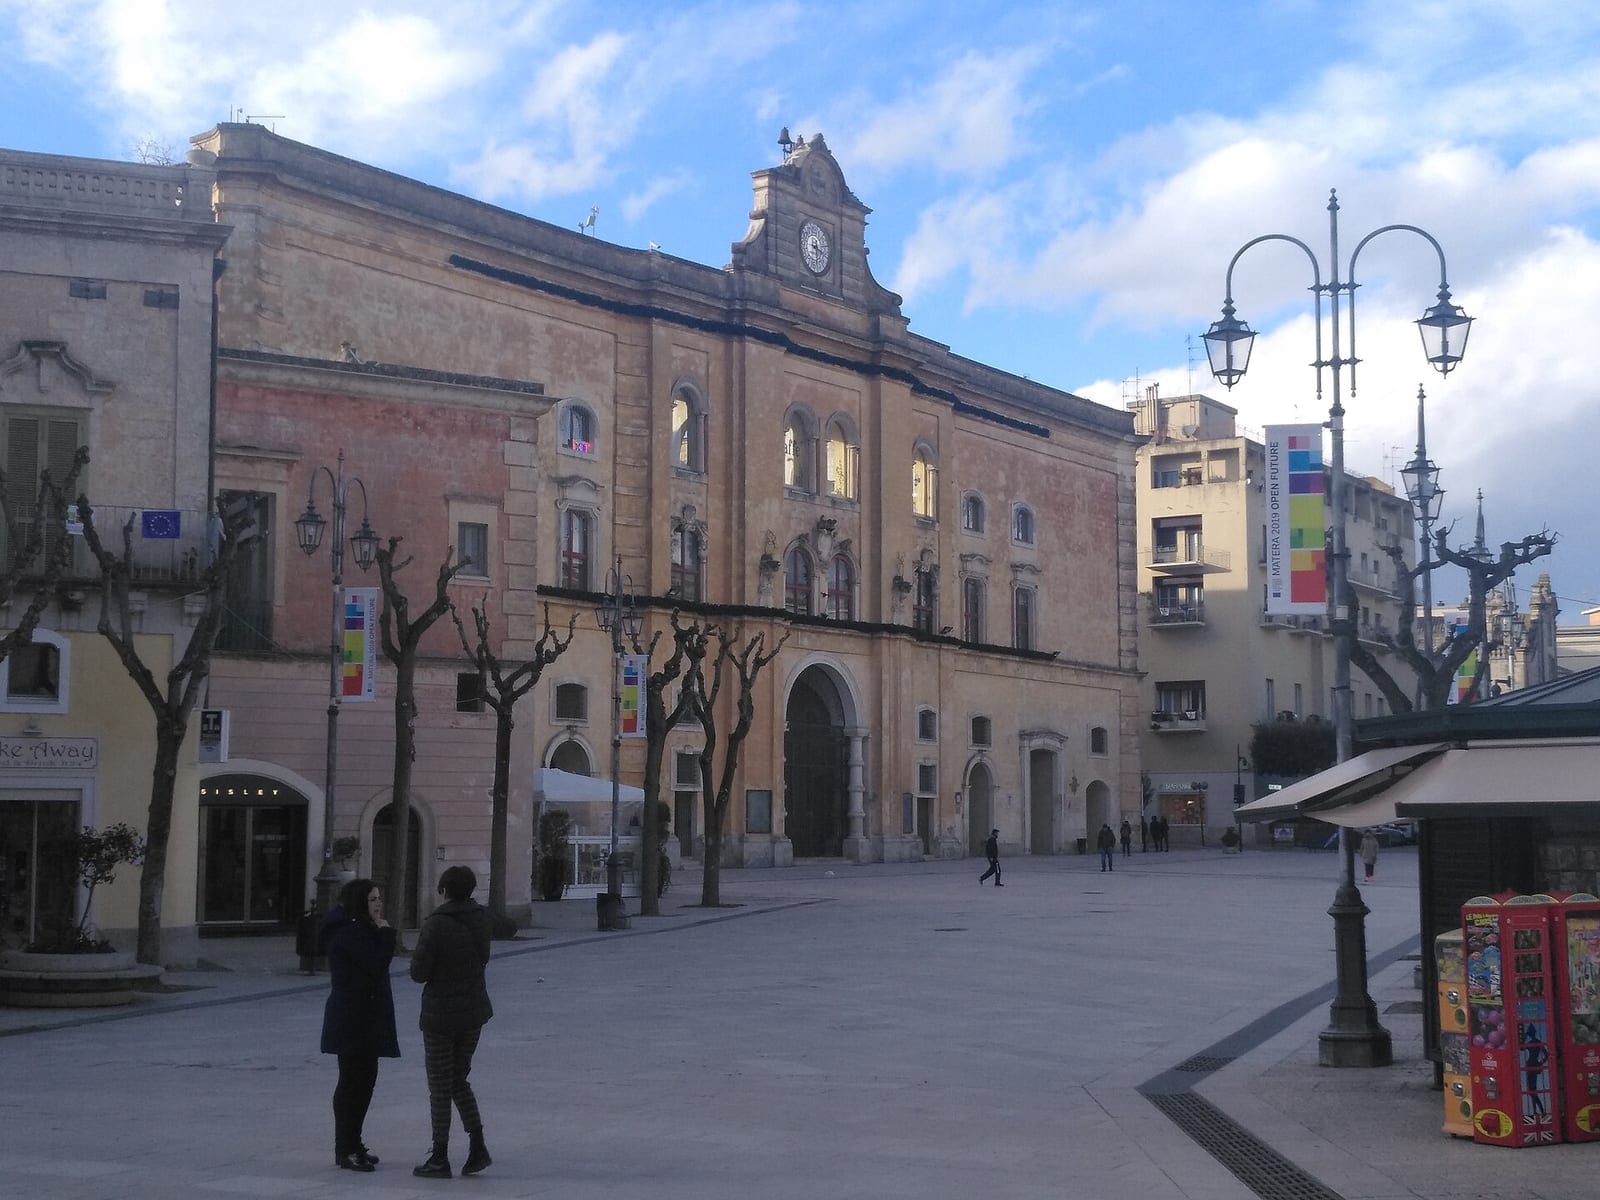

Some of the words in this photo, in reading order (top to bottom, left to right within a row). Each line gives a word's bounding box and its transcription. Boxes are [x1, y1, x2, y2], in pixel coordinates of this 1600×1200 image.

[1270, 441, 1280, 480] FUTURE
[1271, 483, 1280, 511] OPEN
[1272, 512, 1281, 535] 2019
[1272, 537, 1281, 576] MATERA
[29, 741, 94, 762] Away
[200, 788, 279, 796] SISLEY
